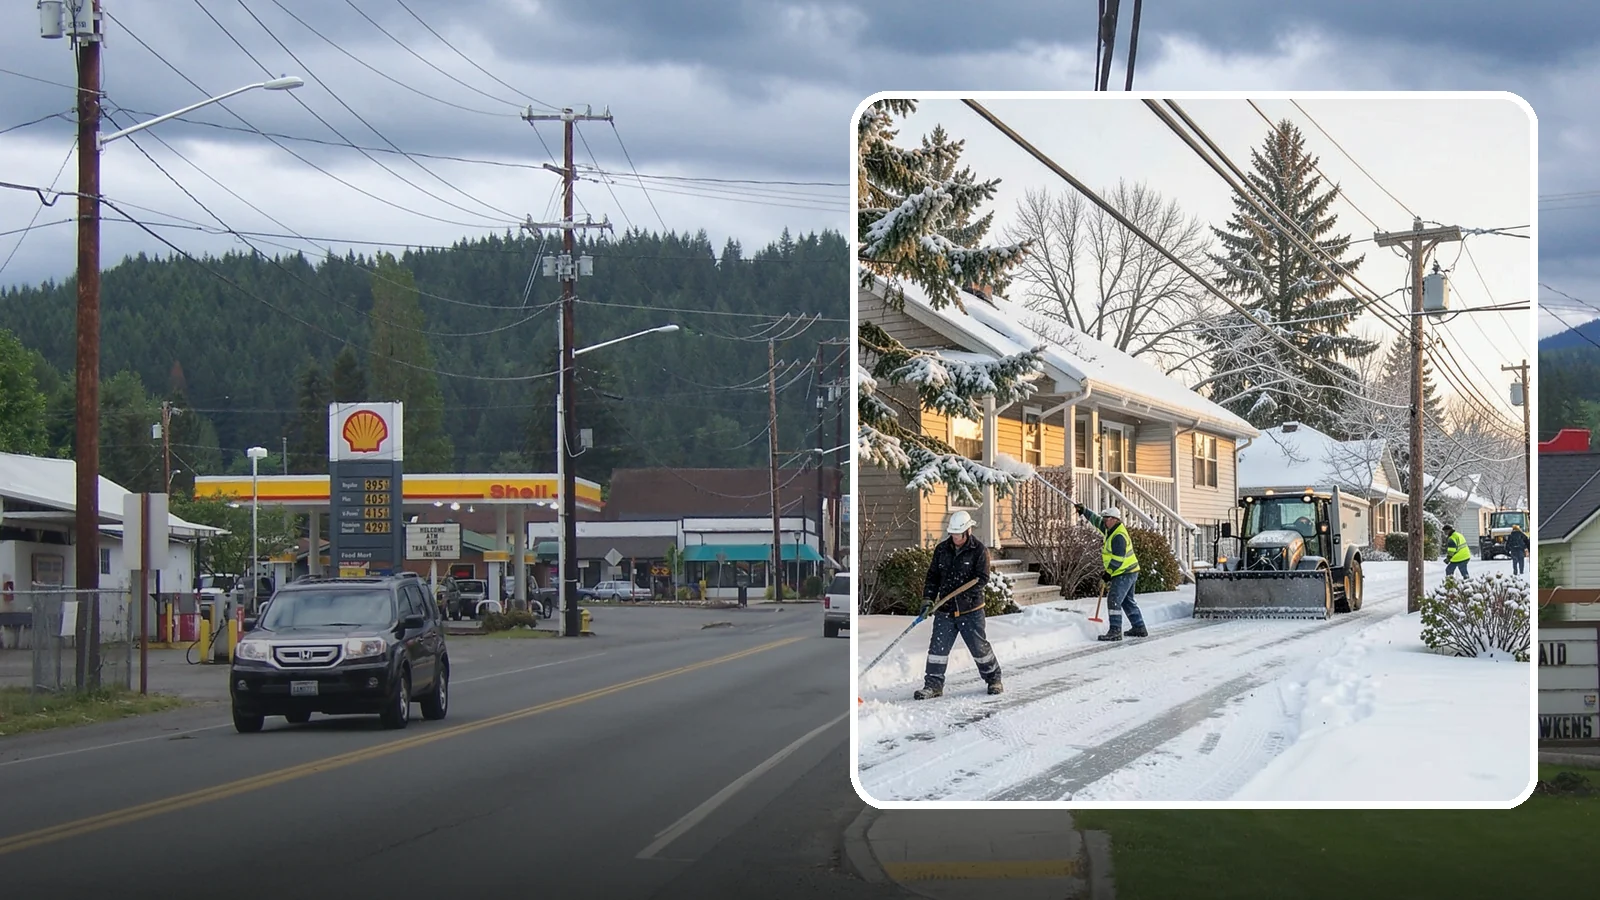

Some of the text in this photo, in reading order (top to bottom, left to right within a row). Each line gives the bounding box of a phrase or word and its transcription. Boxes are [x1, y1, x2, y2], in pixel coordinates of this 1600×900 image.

[365, 480, 384, 490] 395
[490, 484, 547, 499] Shell
[365, 494, 384, 504] 405
[365, 508, 384, 518] 415
[365, 522, 384, 532] 429
[1538, 642, 1567, 666] AID
